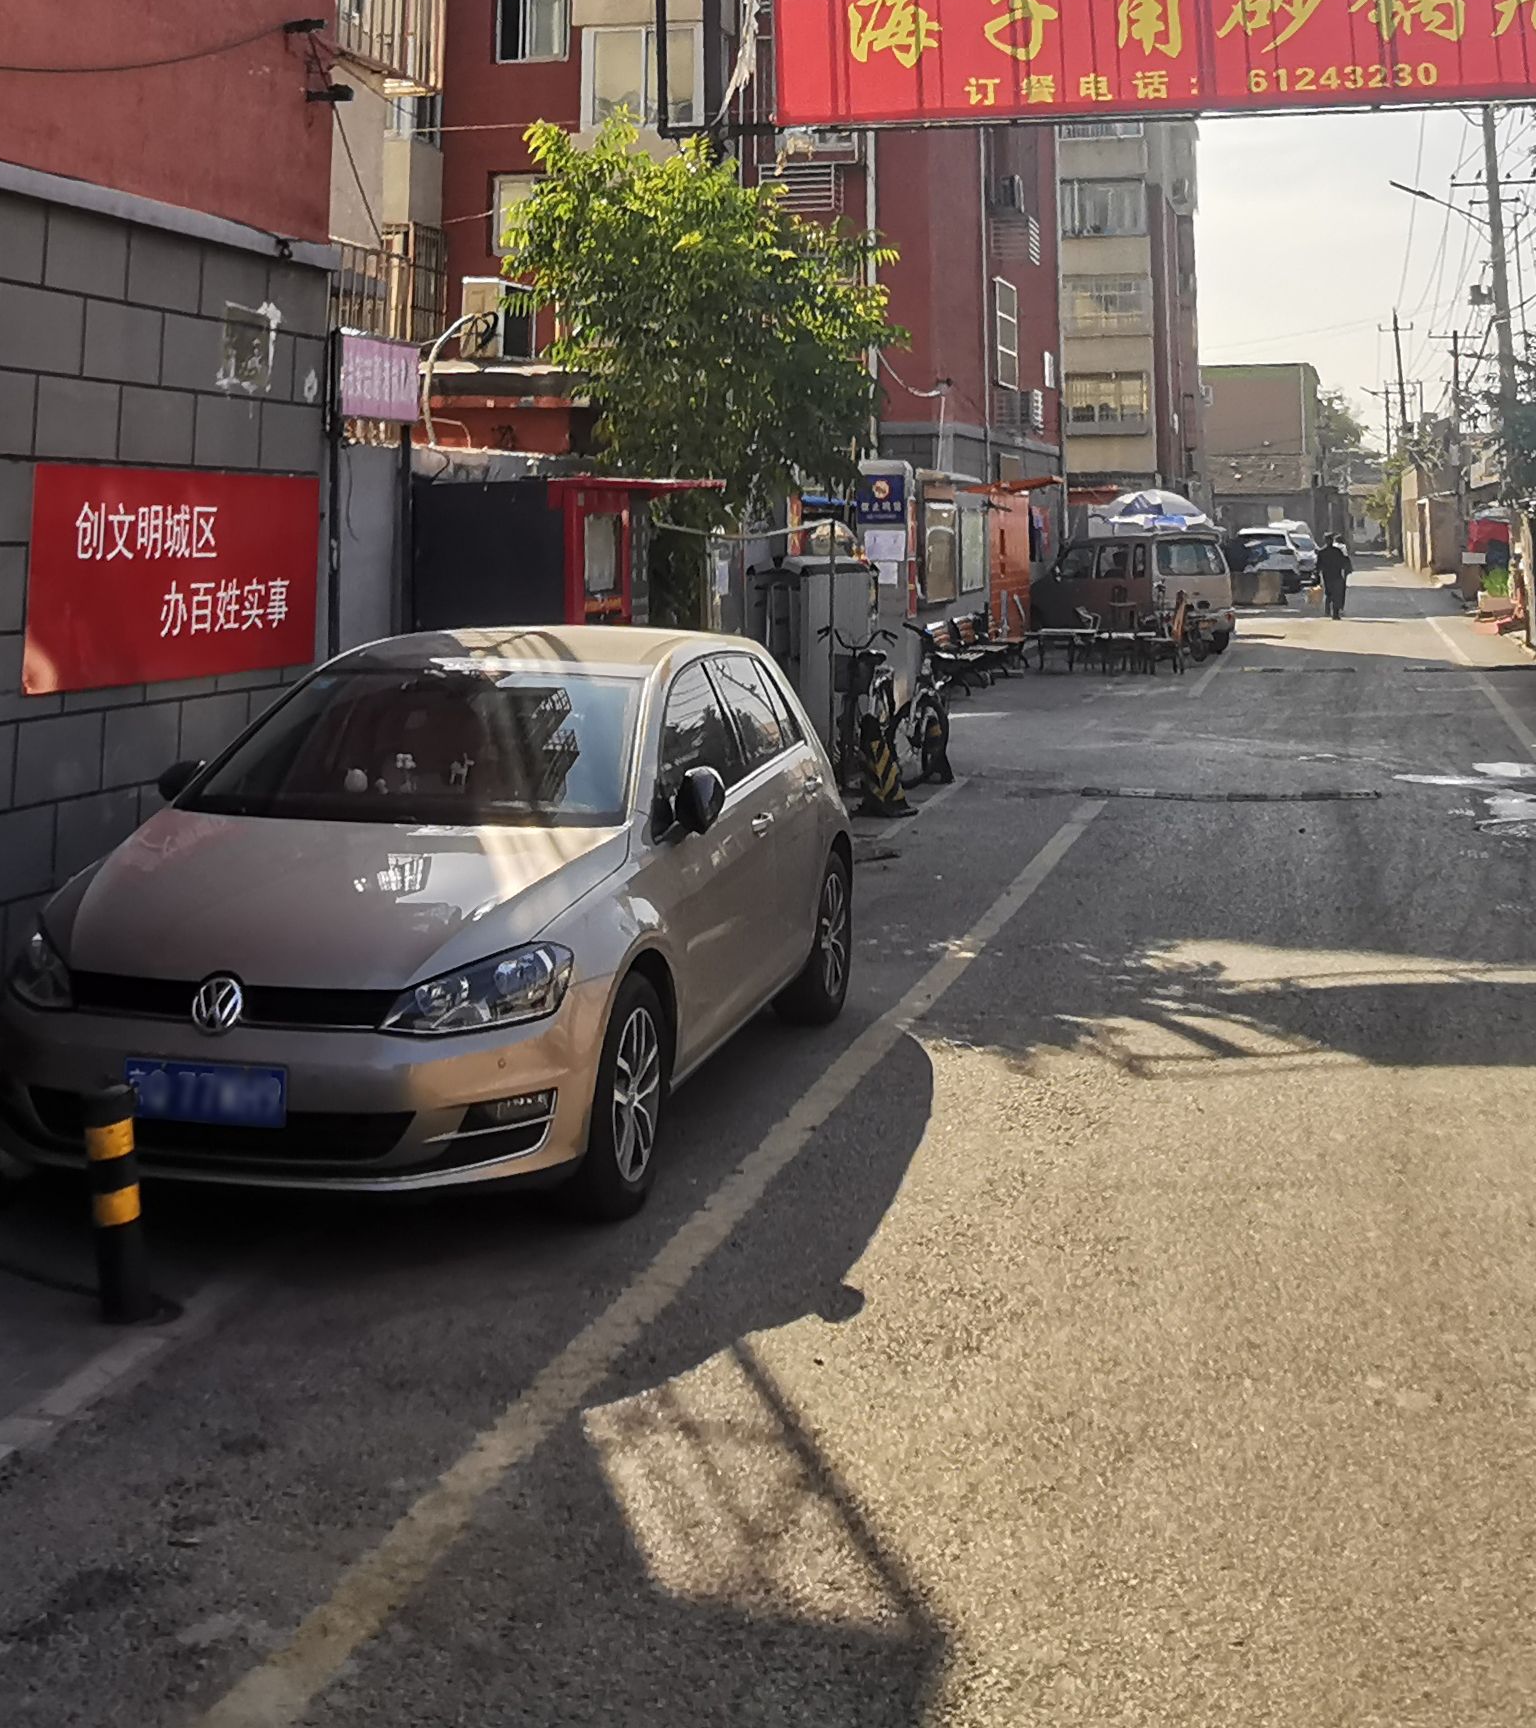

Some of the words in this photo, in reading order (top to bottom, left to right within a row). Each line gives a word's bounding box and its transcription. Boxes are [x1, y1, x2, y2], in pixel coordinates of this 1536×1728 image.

[1248, 61, 1439, 94] 61243230
[75, 500, 218, 562] 创文明城区
[159, 577, 291, 638] 办百姓实事
